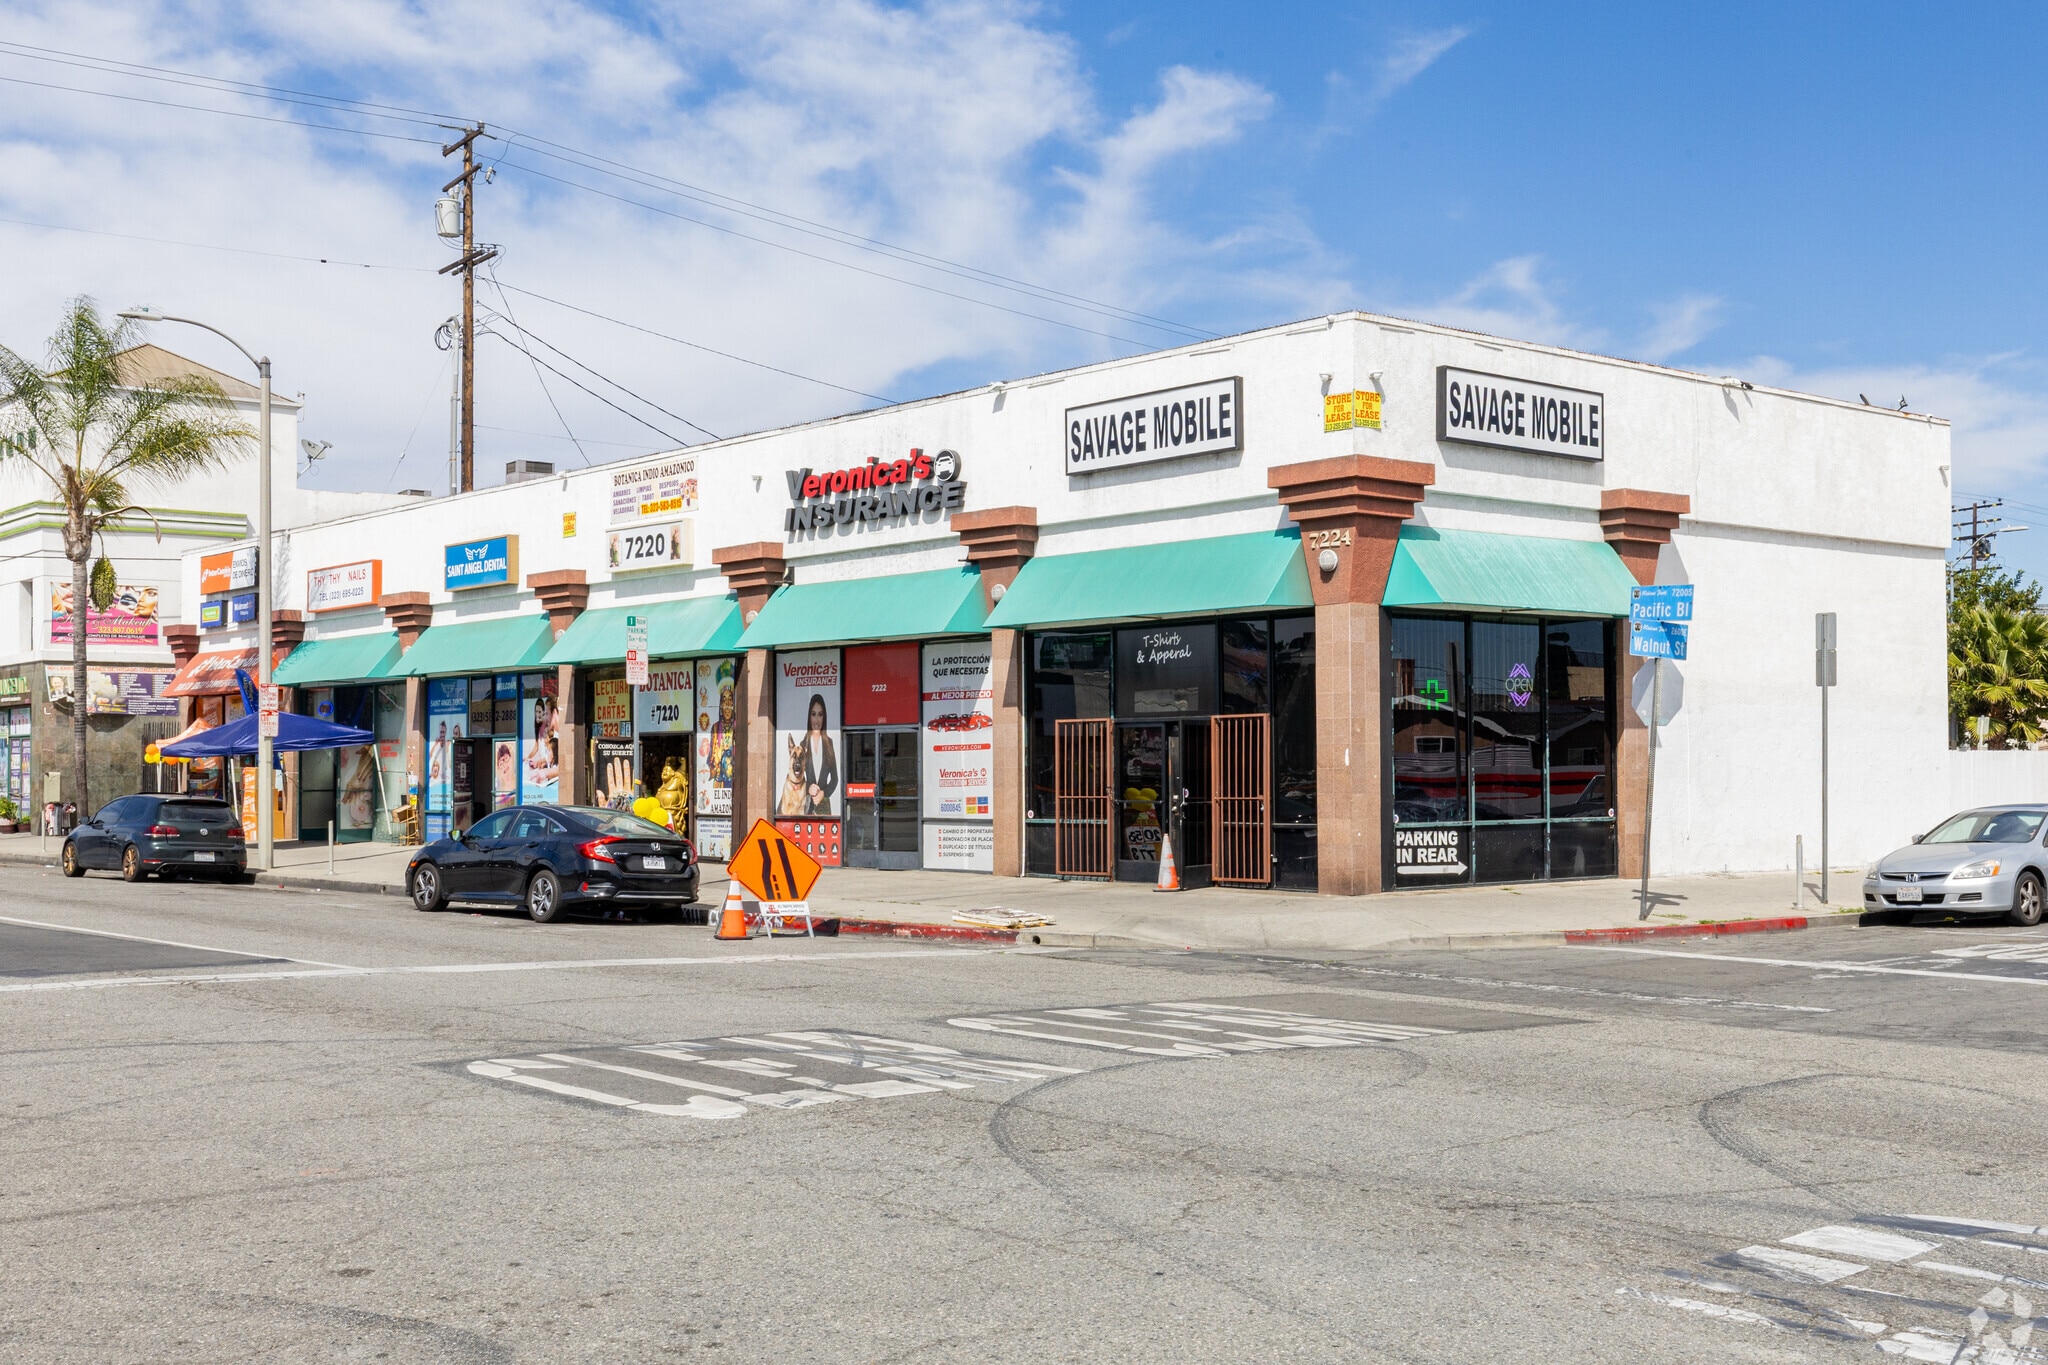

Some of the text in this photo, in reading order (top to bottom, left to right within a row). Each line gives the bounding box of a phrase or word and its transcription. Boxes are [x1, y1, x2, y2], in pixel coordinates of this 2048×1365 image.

[1326, 393, 1352, 406] STORE
[1356, 390, 1380, 402] STORE
[1333, 404, 1345, 413] FOR
[1362, 402, 1373, 410] FOR
[1326, 411, 1352, 423] LEASE
[1355, 409, 1380, 420] LEASE
[1449, 381, 1599, 447] SAVAGE MOBILE
[1071, 393, 1232, 463] SAVAGE MOBILE
[614, 460, 695, 486] BOTANICA INDIO AMAZONICO
[785, 448, 932, 500] Veronica's
[784, 481, 966, 532] INSURANCE
[625, 533, 665, 560] 7220
[1309, 529, 1352, 551] 7224
[447, 557, 507, 578] SAINT ANGEL DENTAL
[329, 572, 341, 585] THY
[348, 568, 366, 581] NAILS
[319, 593, 328, 602] TEL
[1671, 588, 1693, 597] 7200S
[1632, 602, 1689, 618] Pacific Bl
[103, 615, 153, 627] Makeup
[98, 626, 143, 634] 323.807.0619
[1143, 632, 1181, 647] T-Shirts
[1633, 636, 1685, 656] Walnut St
[932, 654, 990, 666] LA PROTECCIÓN
[1136, 644, 1192, 665] & Apperal
[783, 661, 838, 677] Veronica's
[932, 667, 989, 678] QUE NECESITAS
[595, 680, 629, 696] LECTURA
[796, 677, 836, 686] INSURANCE
[871, 684, 887, 692] 7222
[1505, 678, 1533, 691] OPEN
[608, 696, 617, 705] DE
[941, 692, 965, 700] MEJOR
[966, 691, 991, 699] PRECIO
[430, 699, 440, 707] SAINT
[597, 705, 626, 720] CARTAS
[651, 704, 680, 725] #7220
[603, 722, 619, 737] 323
[939, 768, 978, 778] Veronica's
[714, 790, 732, 800] EL IND
[1396, 830, 1458, 846] PARKING
[1396, 847, 1458, 863] IN REAR
